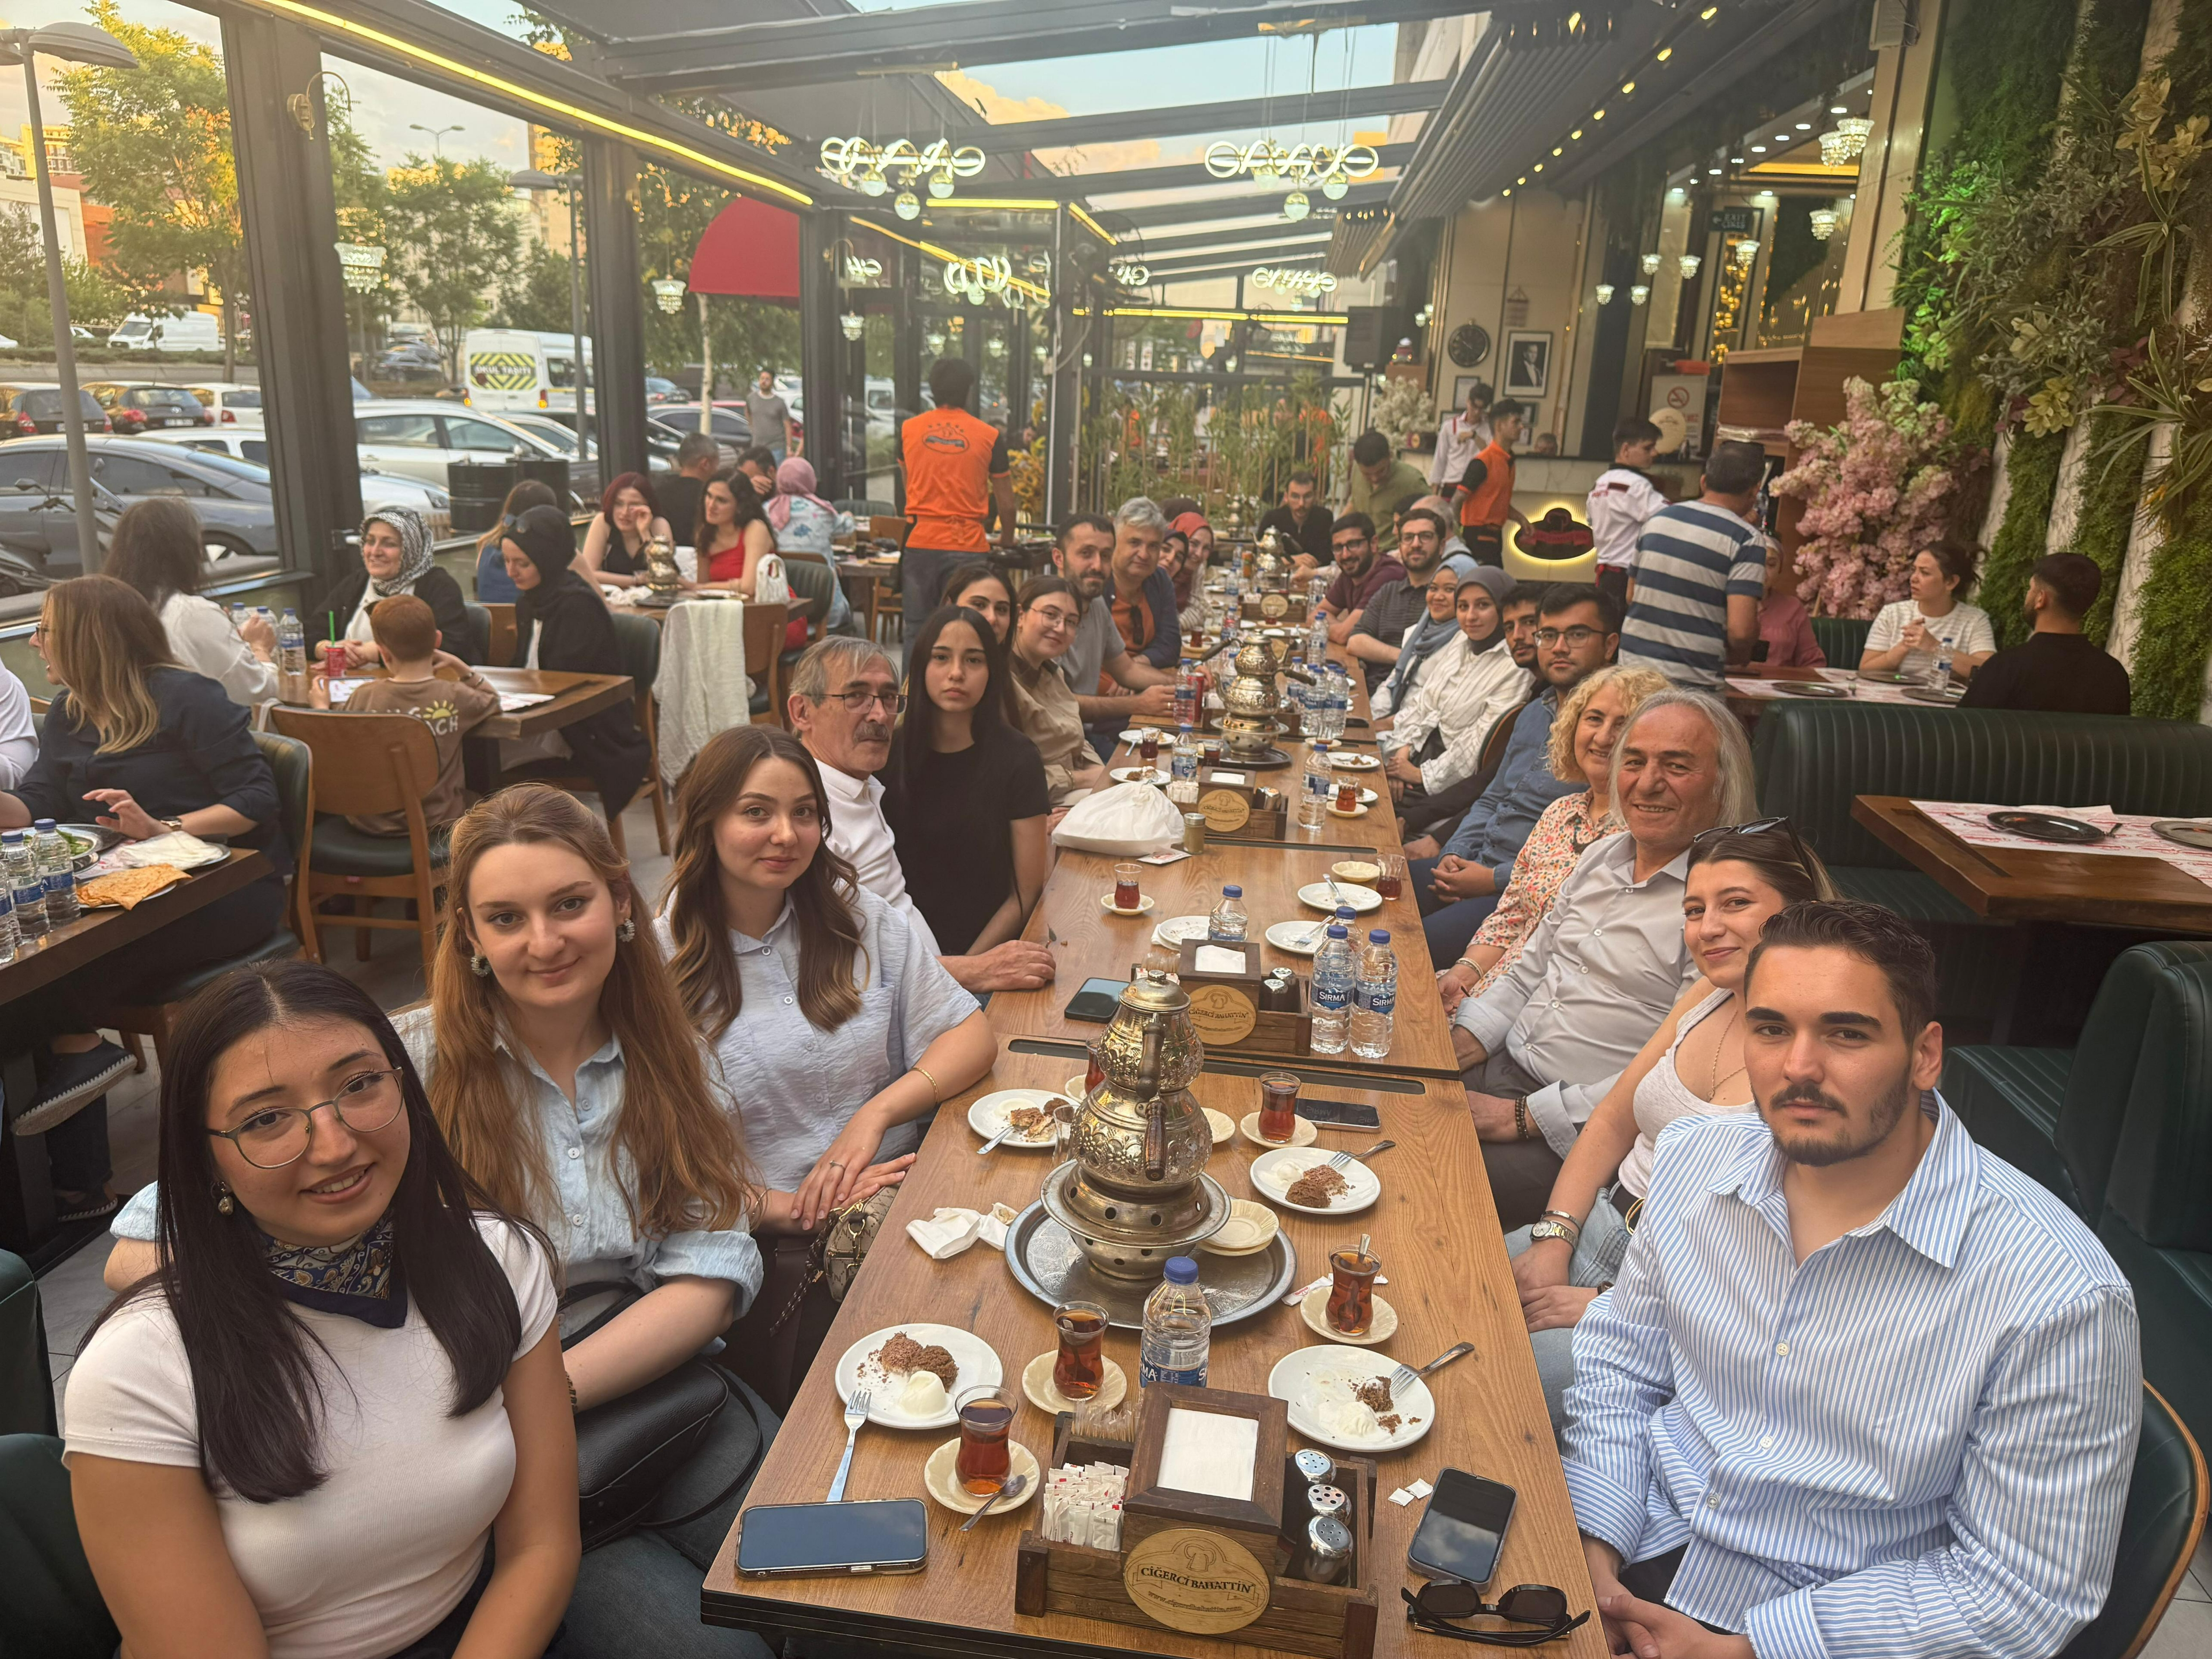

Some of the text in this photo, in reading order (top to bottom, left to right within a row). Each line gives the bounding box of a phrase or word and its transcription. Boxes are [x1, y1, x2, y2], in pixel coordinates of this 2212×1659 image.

[1319, 991, 1345, 1002] SIRMA
[1141, 1566, 1251, 1593] CİĞERCİ BAHATTİN
